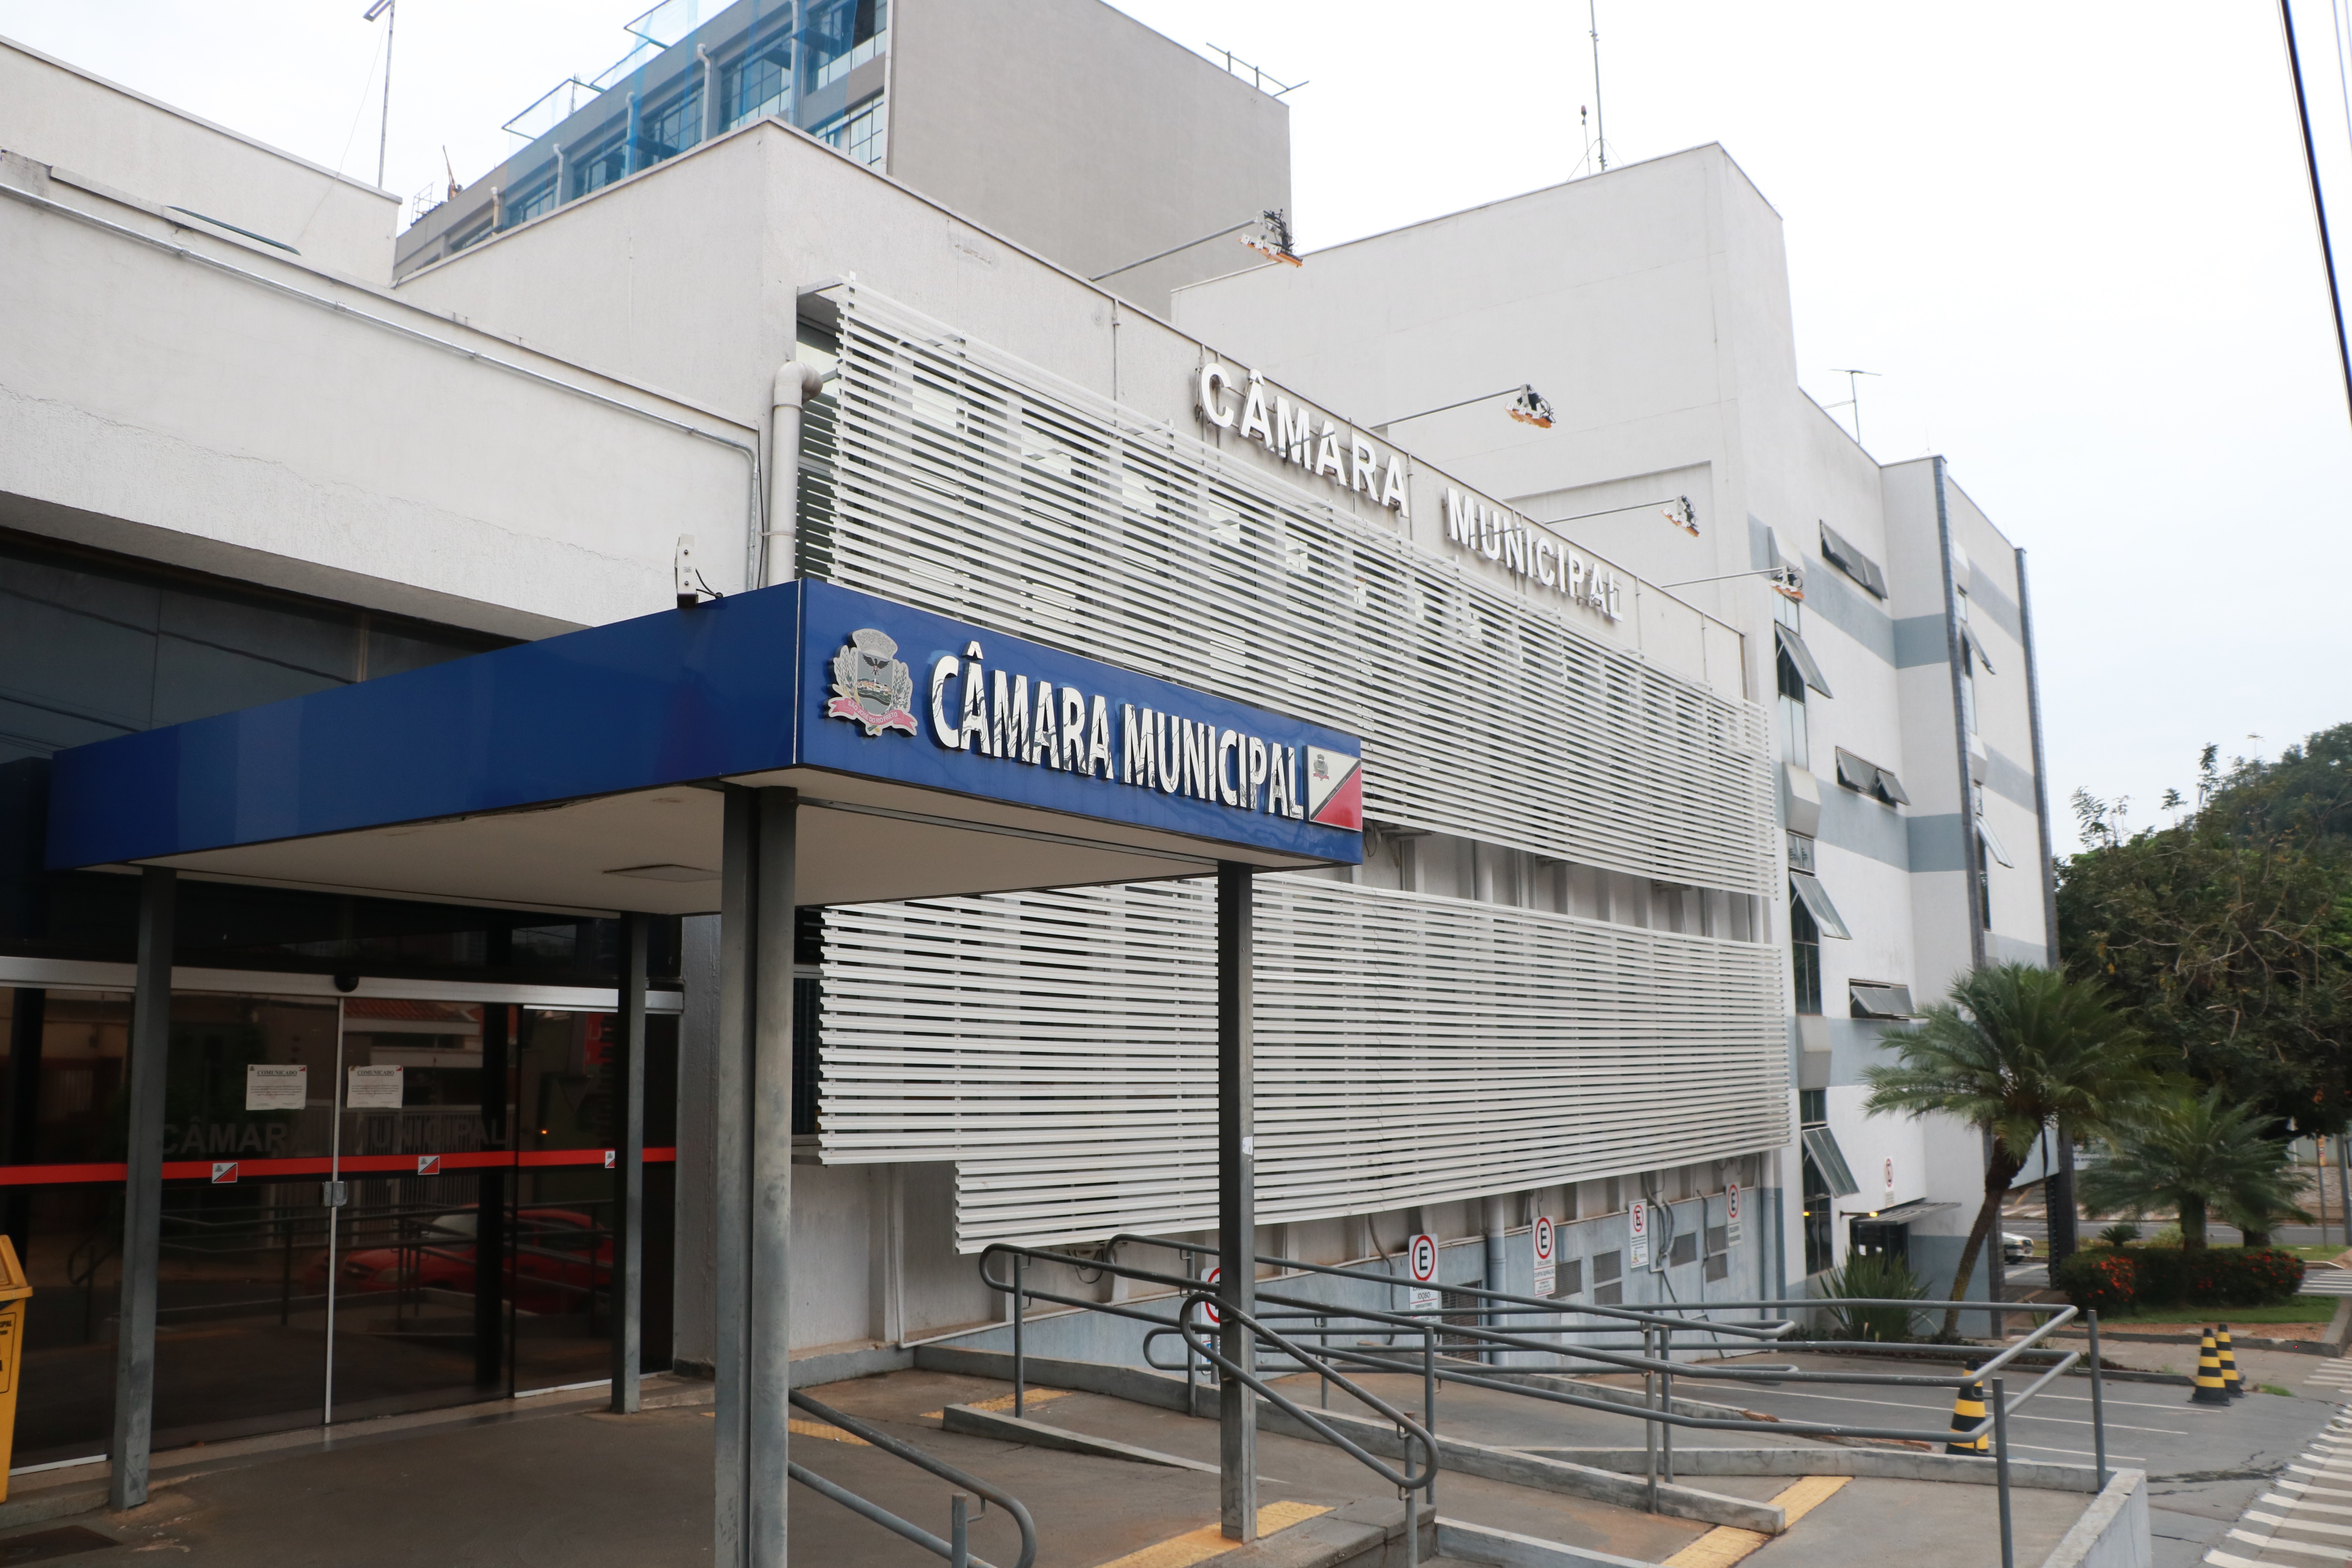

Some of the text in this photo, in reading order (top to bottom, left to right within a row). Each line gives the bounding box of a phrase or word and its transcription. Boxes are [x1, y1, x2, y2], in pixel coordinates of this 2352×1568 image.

[1199, 363, 1624, 622] CÂMARA MUNICIPAL
[848, 701, 858, 710] SÃO
[857, 709, 869, 720] JOSÉ
[883, 711, 898, 721] PRETO
[928, 641, 1304, 820] CÂMARA MUNICIPAL
[1541, 1227, 1548, 1249] E
[1419, 1246, 1428, 1270] E
